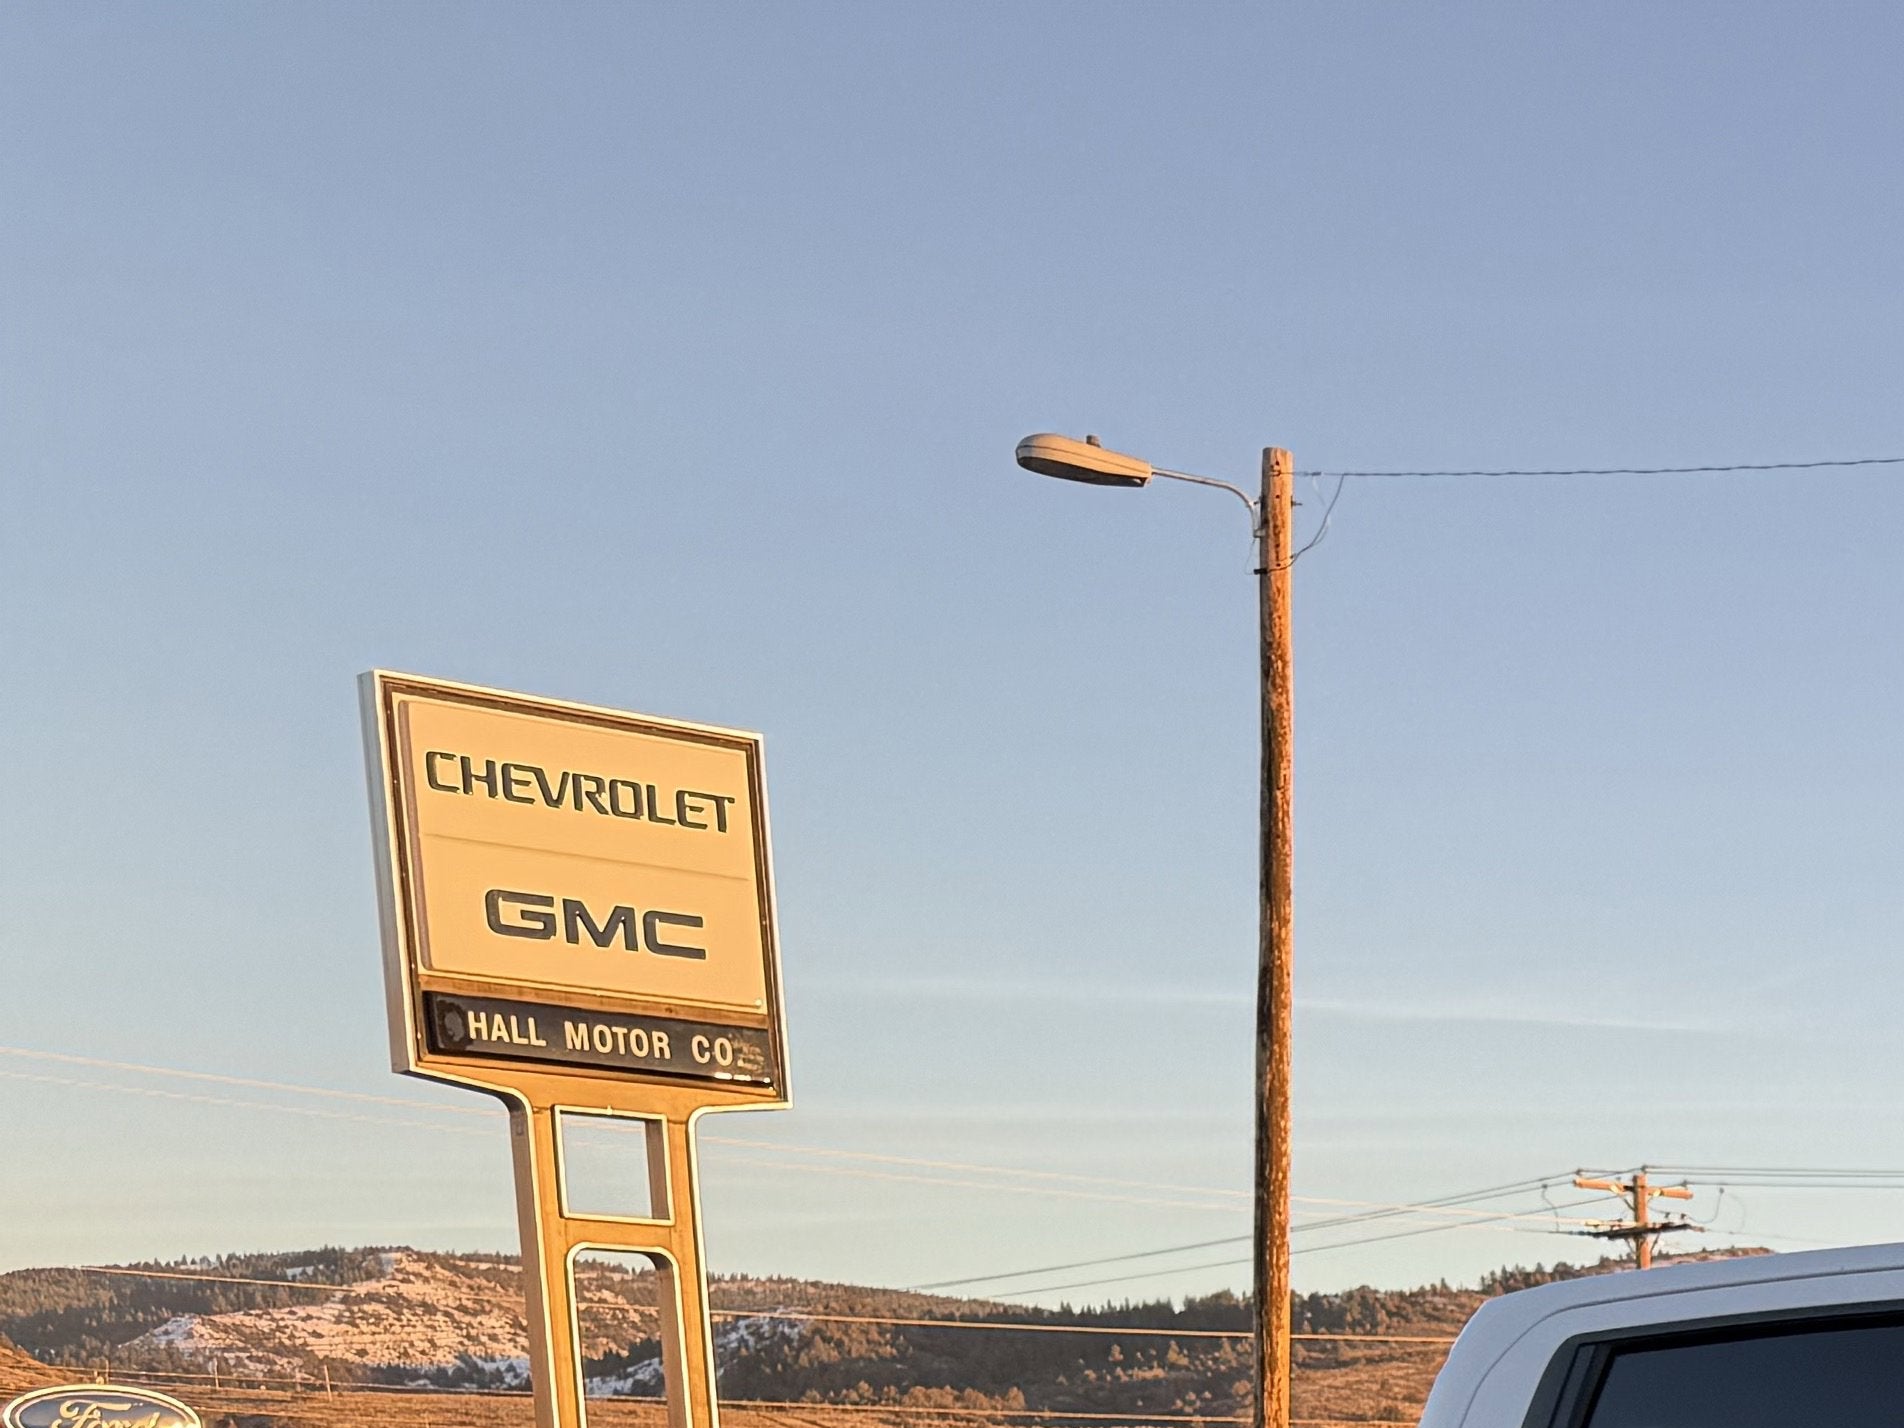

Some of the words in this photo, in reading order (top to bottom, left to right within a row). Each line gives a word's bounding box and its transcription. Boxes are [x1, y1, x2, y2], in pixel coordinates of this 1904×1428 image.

[425, 750, 735, 833] CHEVROLET
[484, 889, 706, 960] GMC
[467, 1010, 547, 1047] HALL
[564, 1020, 672, 1060] MOTOR
